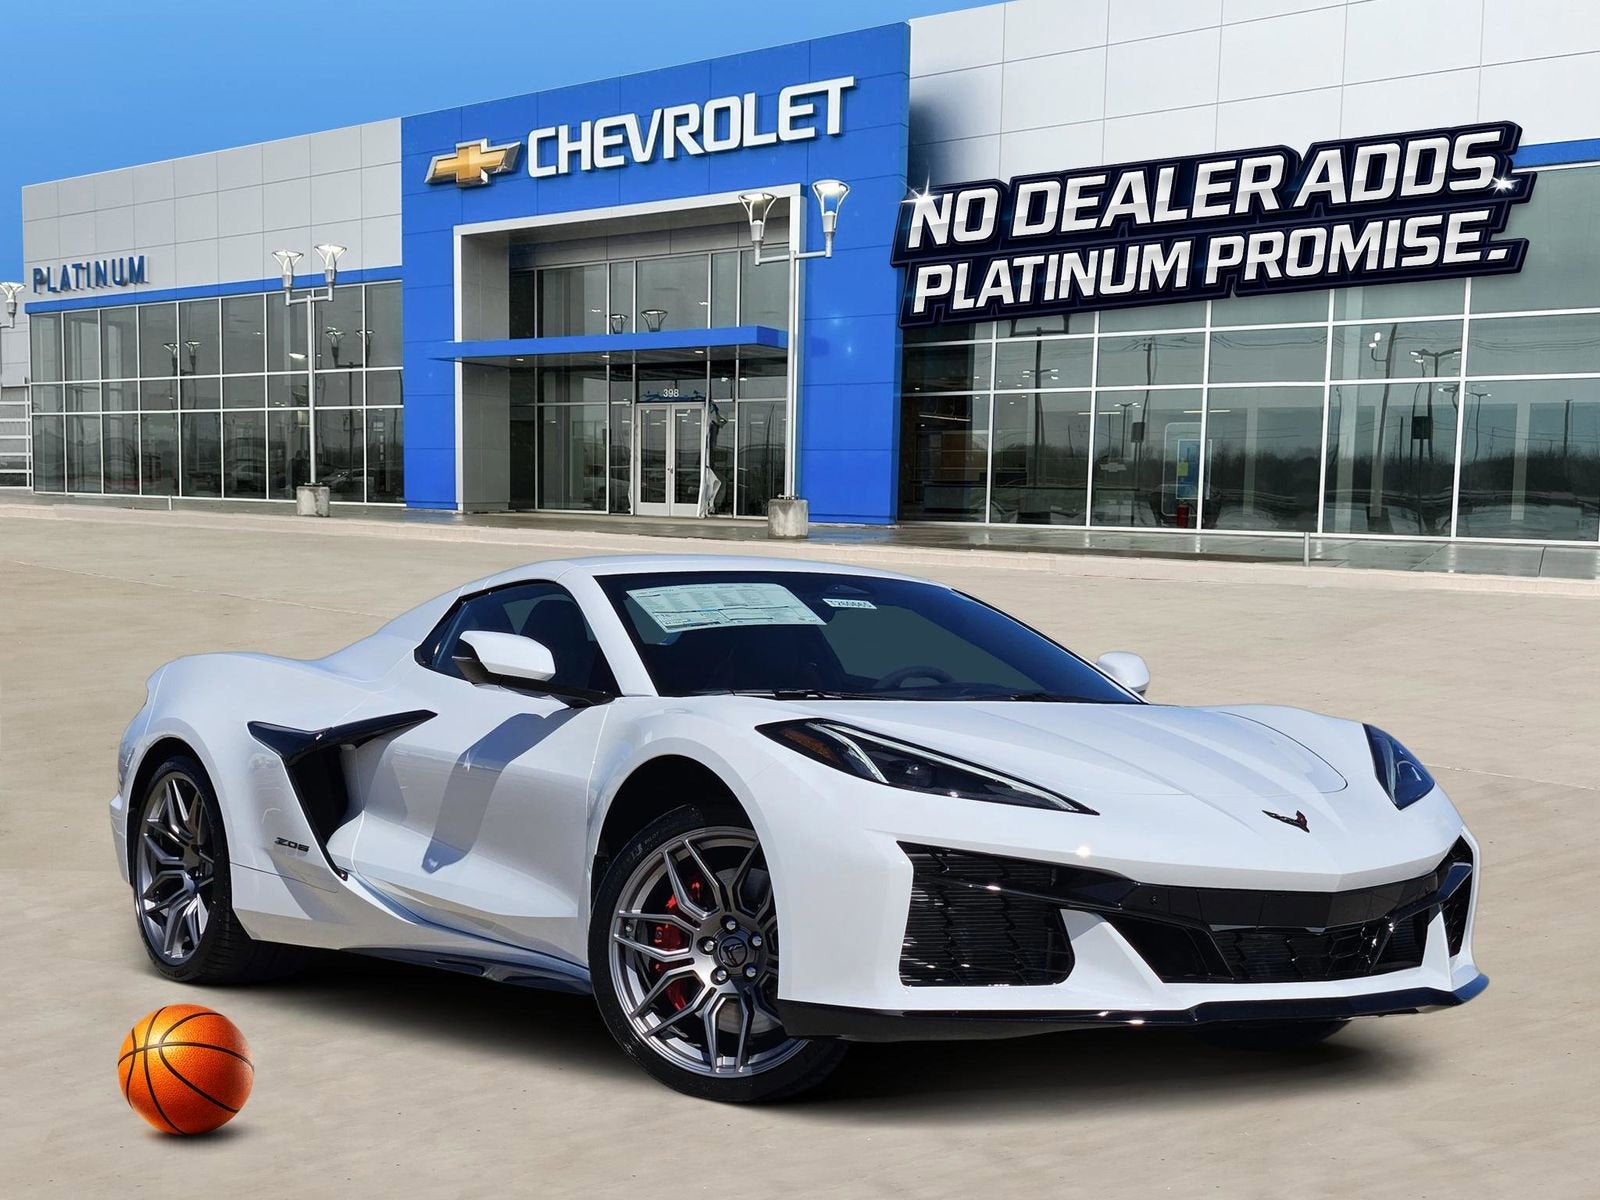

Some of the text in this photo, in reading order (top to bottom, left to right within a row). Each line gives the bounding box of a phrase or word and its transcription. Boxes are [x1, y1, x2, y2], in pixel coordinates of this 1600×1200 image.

[528, 76, 855, 178] CHEVROLET
[33, 256, 146, 293] PLATINUM
[663, 388, 680, 398] 398
